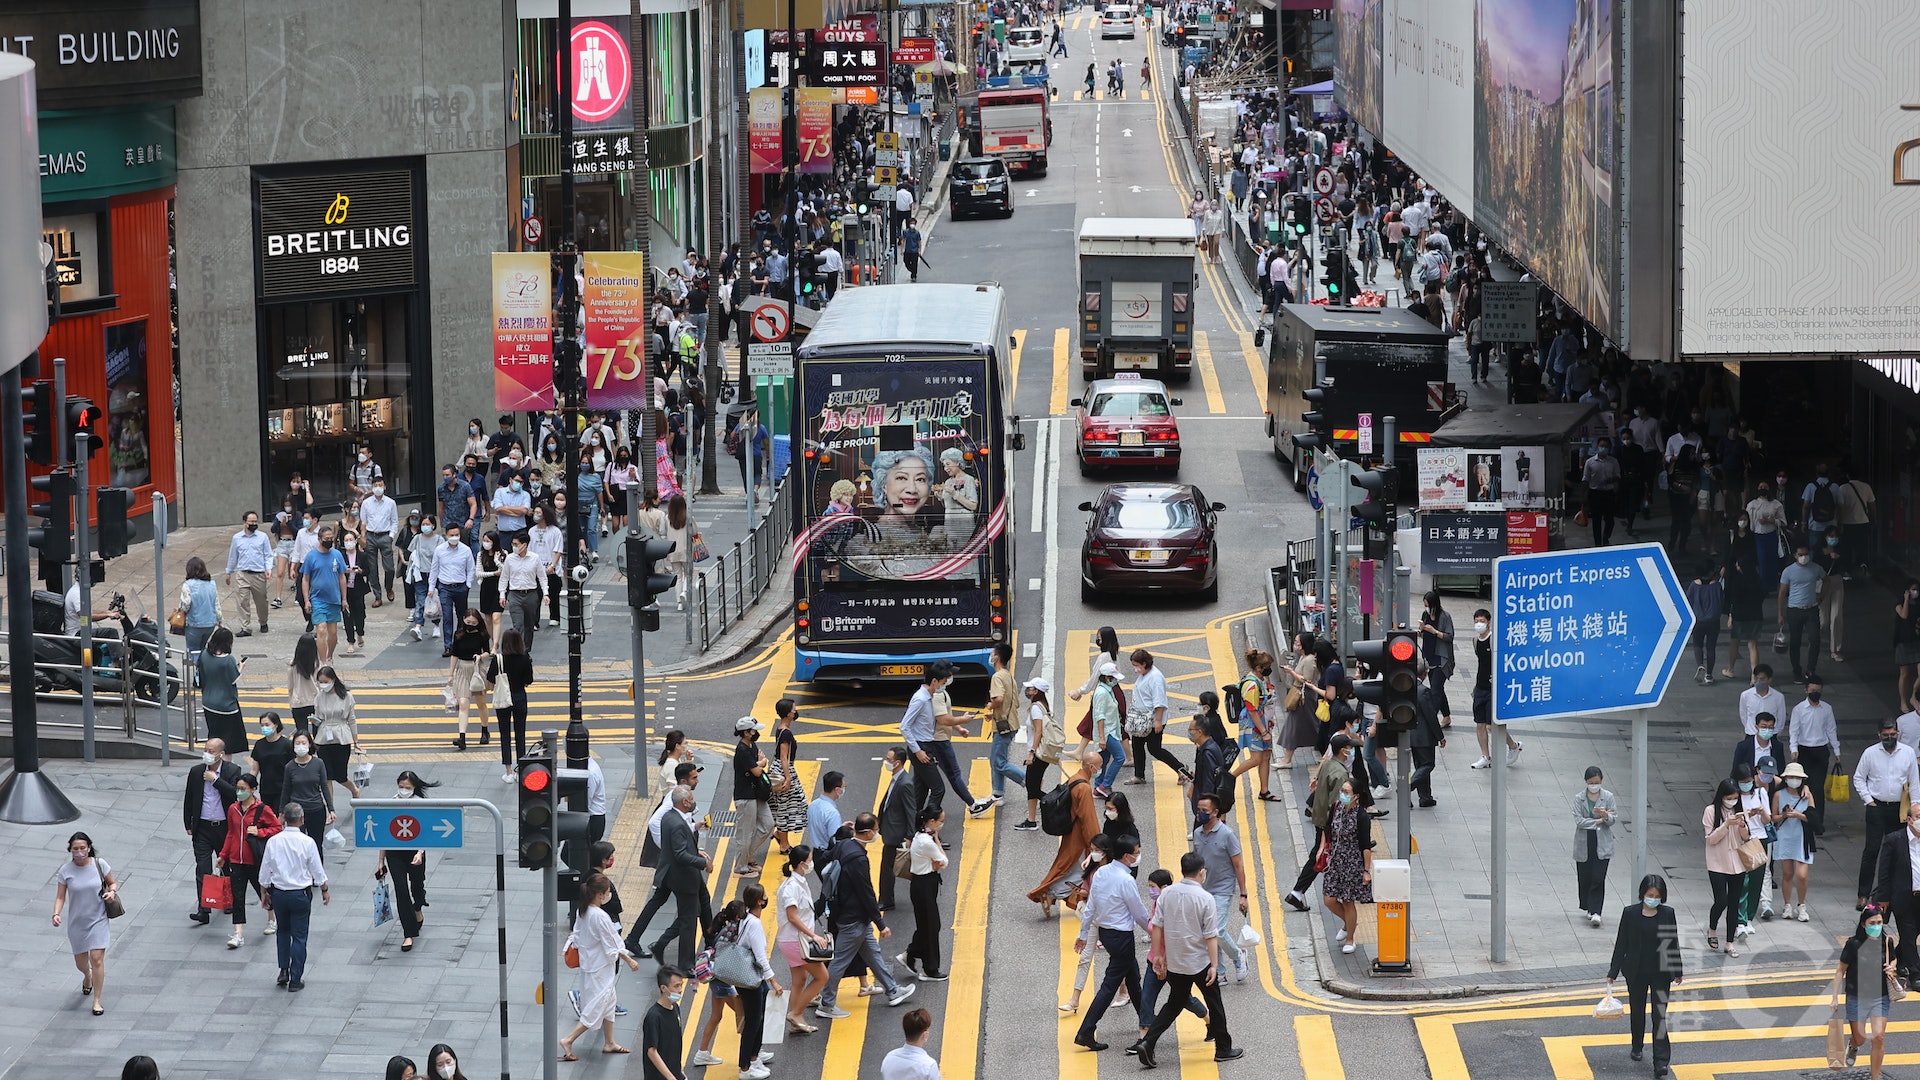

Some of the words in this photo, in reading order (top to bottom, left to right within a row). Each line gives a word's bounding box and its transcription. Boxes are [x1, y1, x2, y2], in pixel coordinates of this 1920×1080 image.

[830, 20, 861, 30] FIVE
[824, 32, 866, 42] GUYS
[58, 28, 180, 64] BUILDING
[823, 50, 876, 67] 周大福
[802, 134, 830, 162] 73
[600, 161, 625, 172] SENG
[268, 226, 410, 256] BREITLING
[321, 257, 359, 274] 1884
[588, 277, 639, 287] Celebrating
[590, 298, 629, 307] Anniversary
[1707, 308, 1762, 317] APPLICABLE
[1763, 307, 1777, 316] TO
[1779, 307, 1808, 316] PHASE
[1818, 307, 1838, 316] AND
[1840, 307, 1870, 315] PHASE
[1872, 306, 1877, 315] 2
[1879, 306, 1891, 315] OF
[1893, 306, 1912, 315] THE
[498, 317, 547, 329] 熱烈慶祝
[1752, 320, 1778, 330] Sales)
[498, 334, 548, 342] 中華人民共和國
[1707, 334, 1740, 343] imaging
[1794, 332, 1842, 341] Prospective
[1845, 332, 1893, 341] purchasers
[288, 352, 328, 363] BREILING
[498, 354, 549, 365] 七十三周年
[590, 340, 642, 390] 73
[829, 388, 880, 407] 英國升學
[916, 432, 928, 440] BE
[930, 430, 956, 439] LOUD
[1360, 430, 1370, 451] 中環
[829, 440, 841, 449] BE
[843, 437, 878, 448] PROUD
[1430, 527, 1499, 540] 日本語学習
[1506, 568, 1562, 590] Airport
[1570, 565, 1630, 584] Express
[1506, 593, 1573, 615] Station
[835, 616, 876, 625] Britannia
[930, 618, 953, 626] 5500
[956, 617, 979, 625] 3655
[1507, 610, 1628, 647] 機場快綫站
[1504, 650, 1585, 672] Kowloon
[1506, 675, 1552, 705] 九龍
